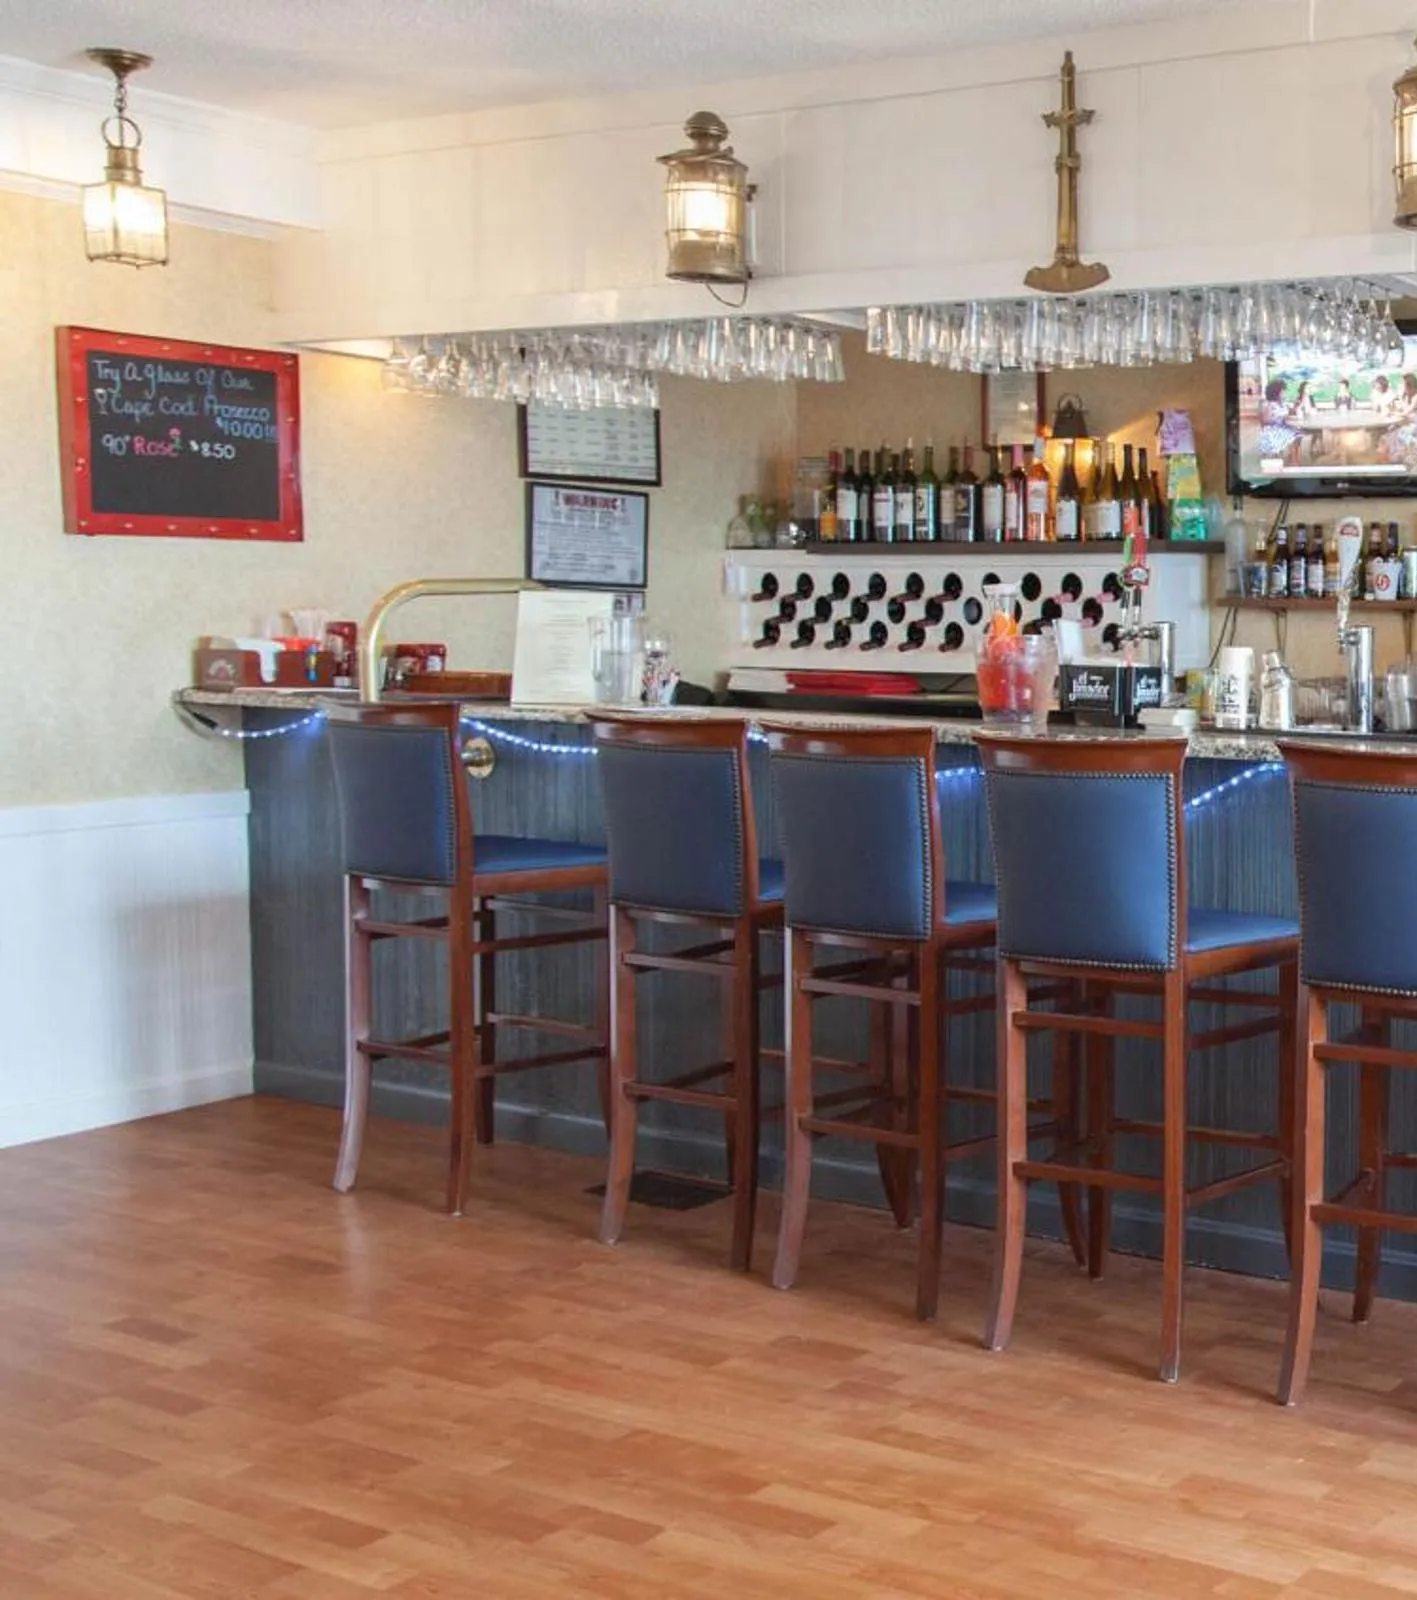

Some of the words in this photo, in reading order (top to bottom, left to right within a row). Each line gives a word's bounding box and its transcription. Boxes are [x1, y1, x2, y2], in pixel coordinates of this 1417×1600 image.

[93, 360, 121, 393] Try
[111, 395, 154, 422] Cape
[159, 396, 198, 416] Cod
[204, 394, 271, 421] Prosecco
